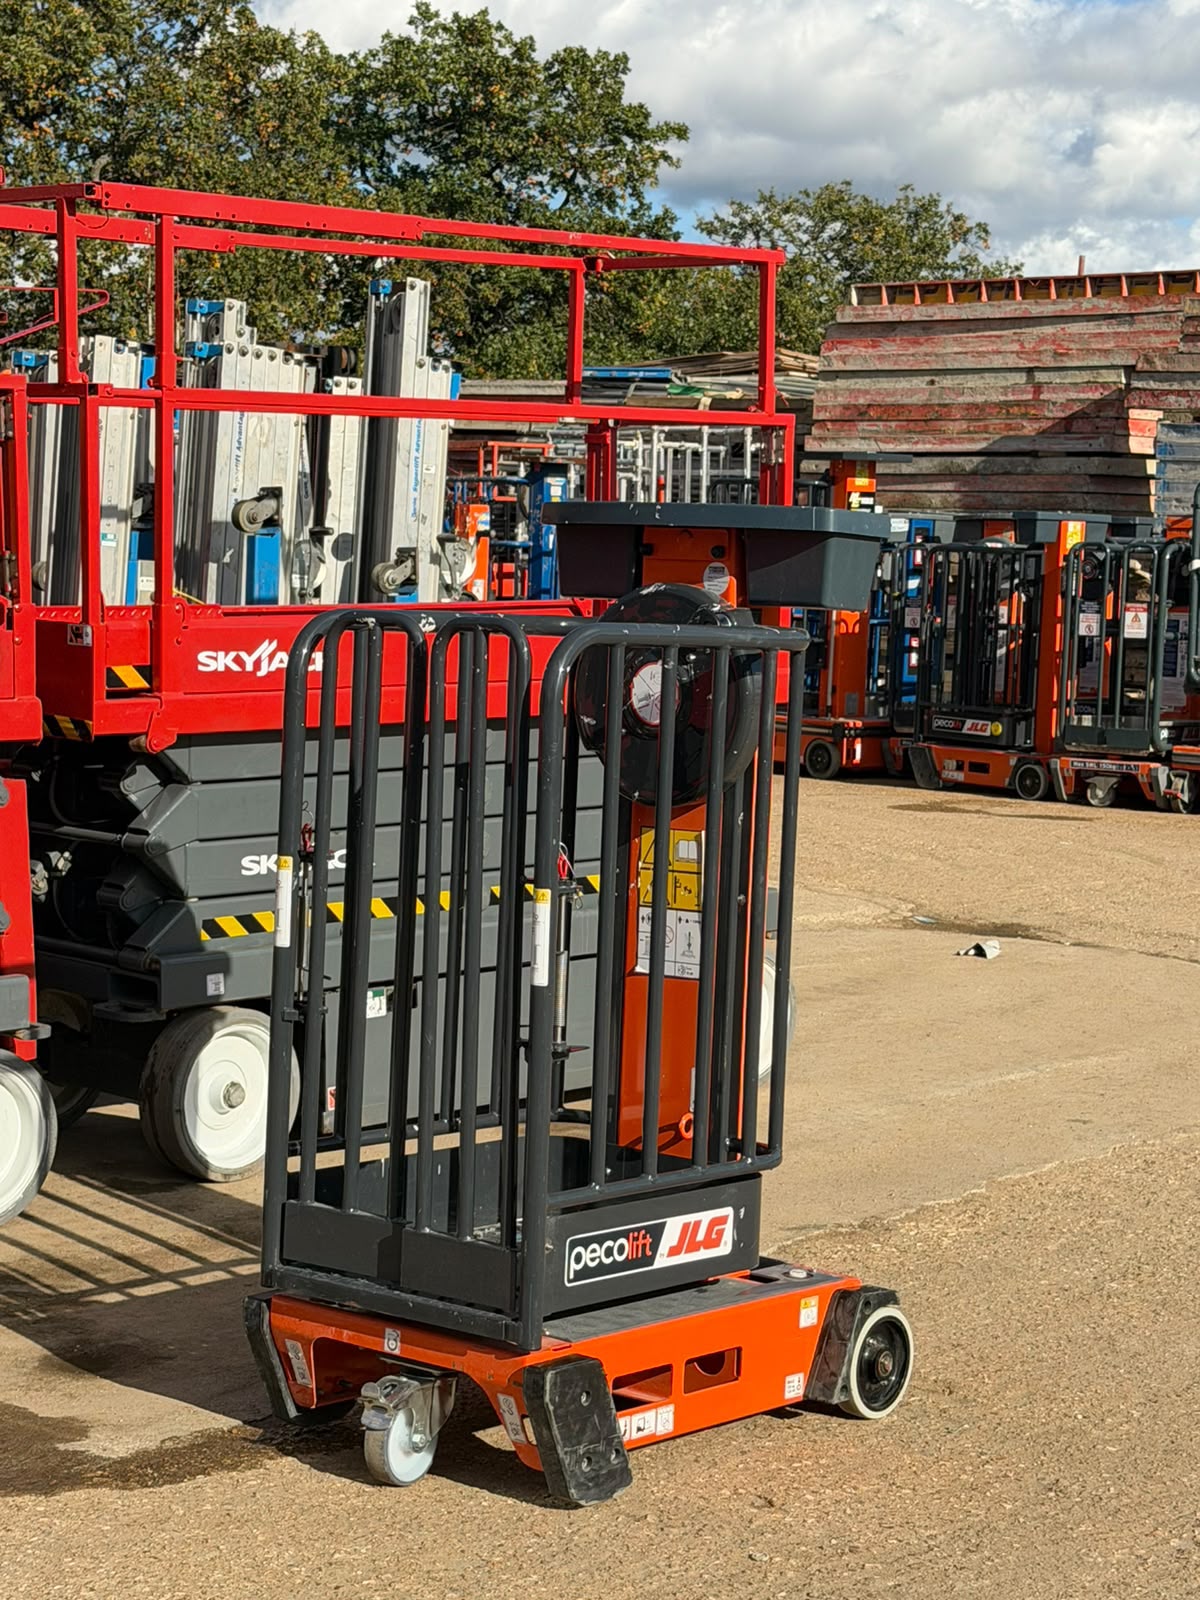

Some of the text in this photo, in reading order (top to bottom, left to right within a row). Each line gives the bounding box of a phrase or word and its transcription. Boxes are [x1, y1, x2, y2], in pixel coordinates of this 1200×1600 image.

[236, 412, 246, 452] Advantag
[197, 639, 323, 677] SKYJA
[966, 722, 989, 733] JLG
[569, 1229, 653, 1279] pecolift
[666, 1214, 729, 1258] JLG
